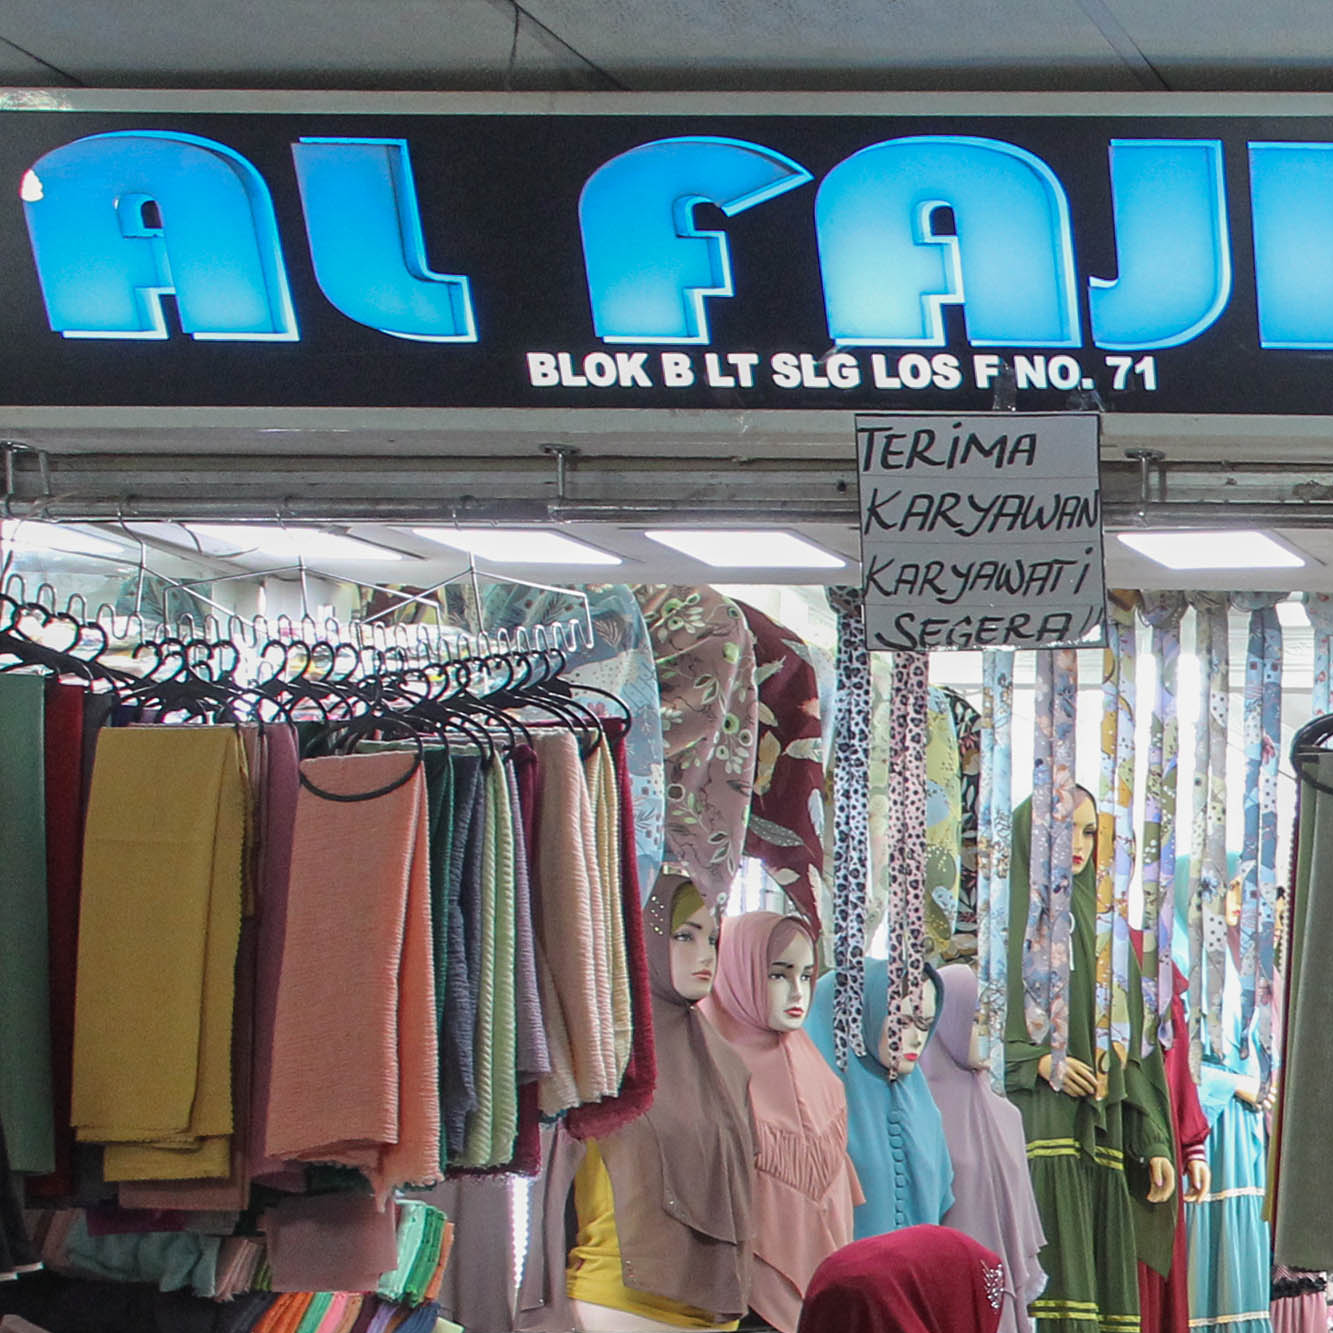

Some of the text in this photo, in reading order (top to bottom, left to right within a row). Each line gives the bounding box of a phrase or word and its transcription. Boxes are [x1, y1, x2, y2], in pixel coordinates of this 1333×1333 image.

[20, 130, 478, 342] AL
[526, 352, 1158, 391] BLOK B LT SLG LOS F NO. 71
[864, 488, 1099, 537] KARYAWAN
